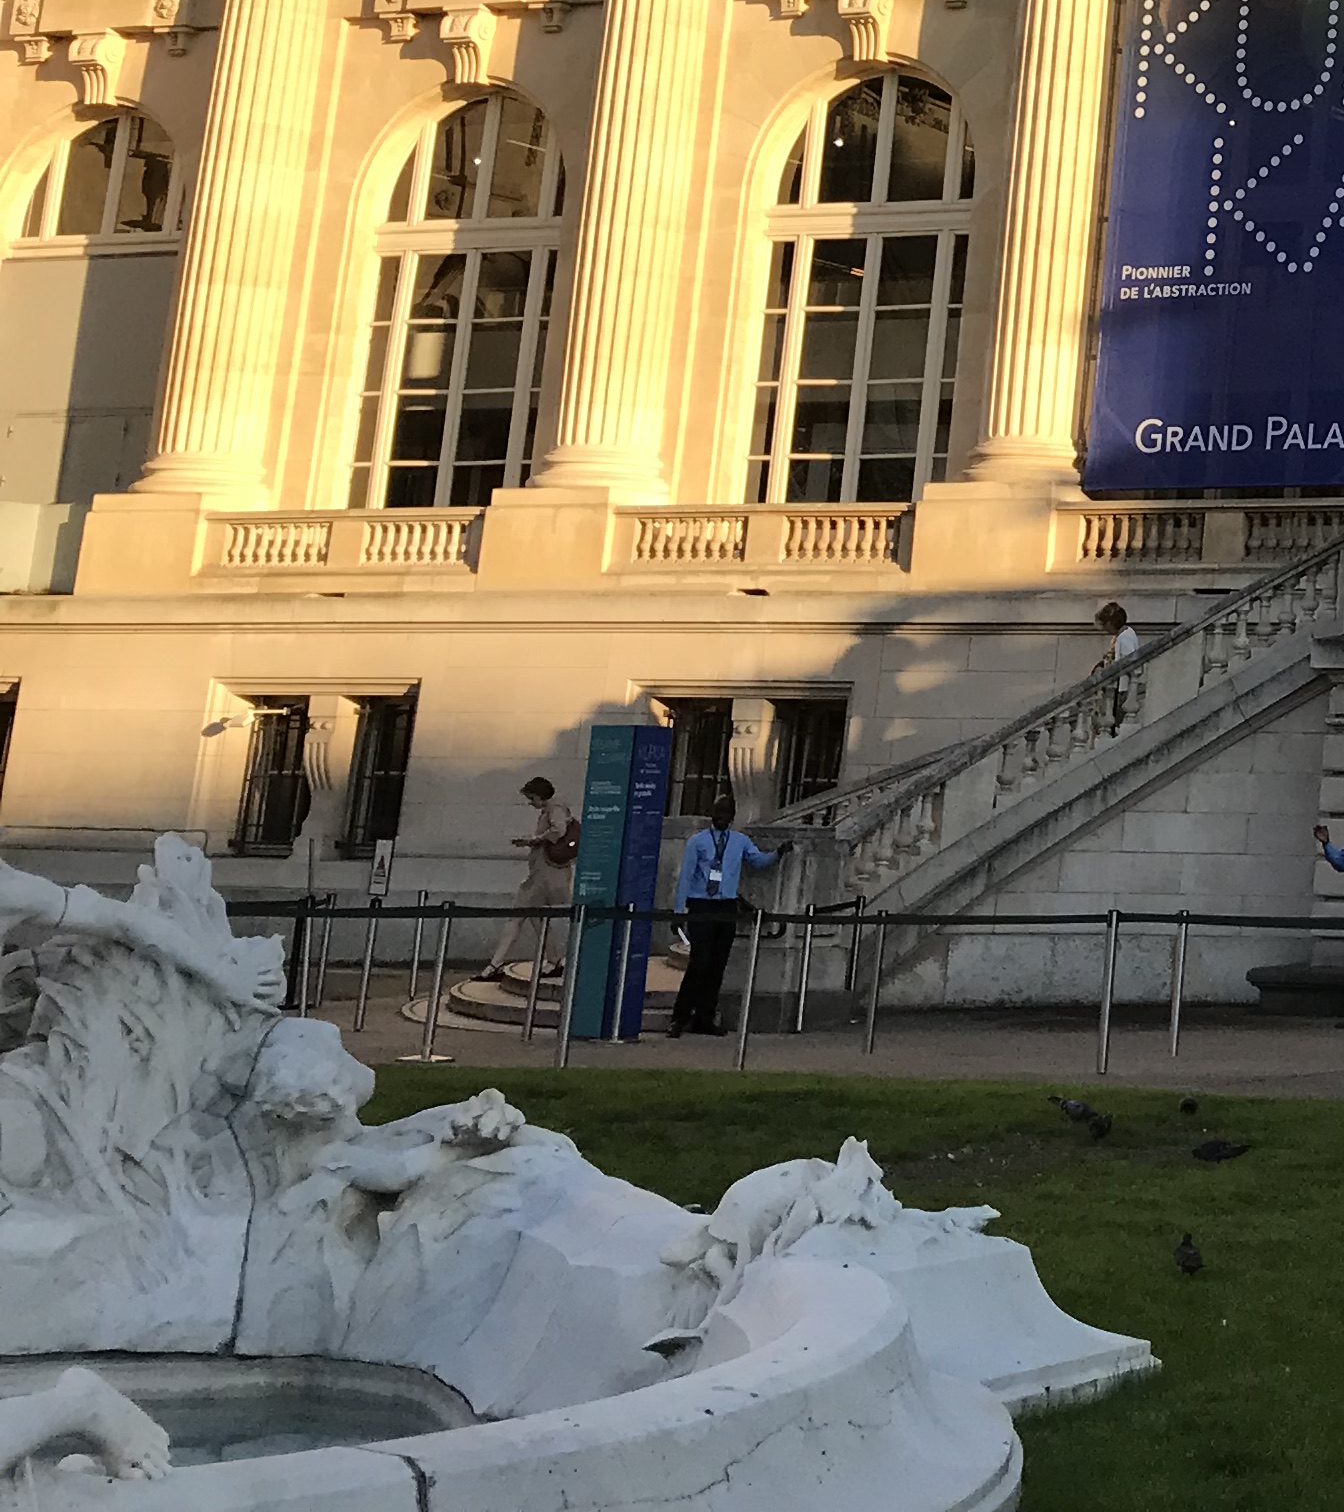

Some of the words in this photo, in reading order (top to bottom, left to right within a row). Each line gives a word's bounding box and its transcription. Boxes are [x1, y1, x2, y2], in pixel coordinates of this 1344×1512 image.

[1121, 265, 1191, 281] PIONNIER
[1120, 287, 1139, 299] DE
[1143, 283, 1252, 299] L'ABSTRACTION
[1135, 418, 1253, 454] GRAND
